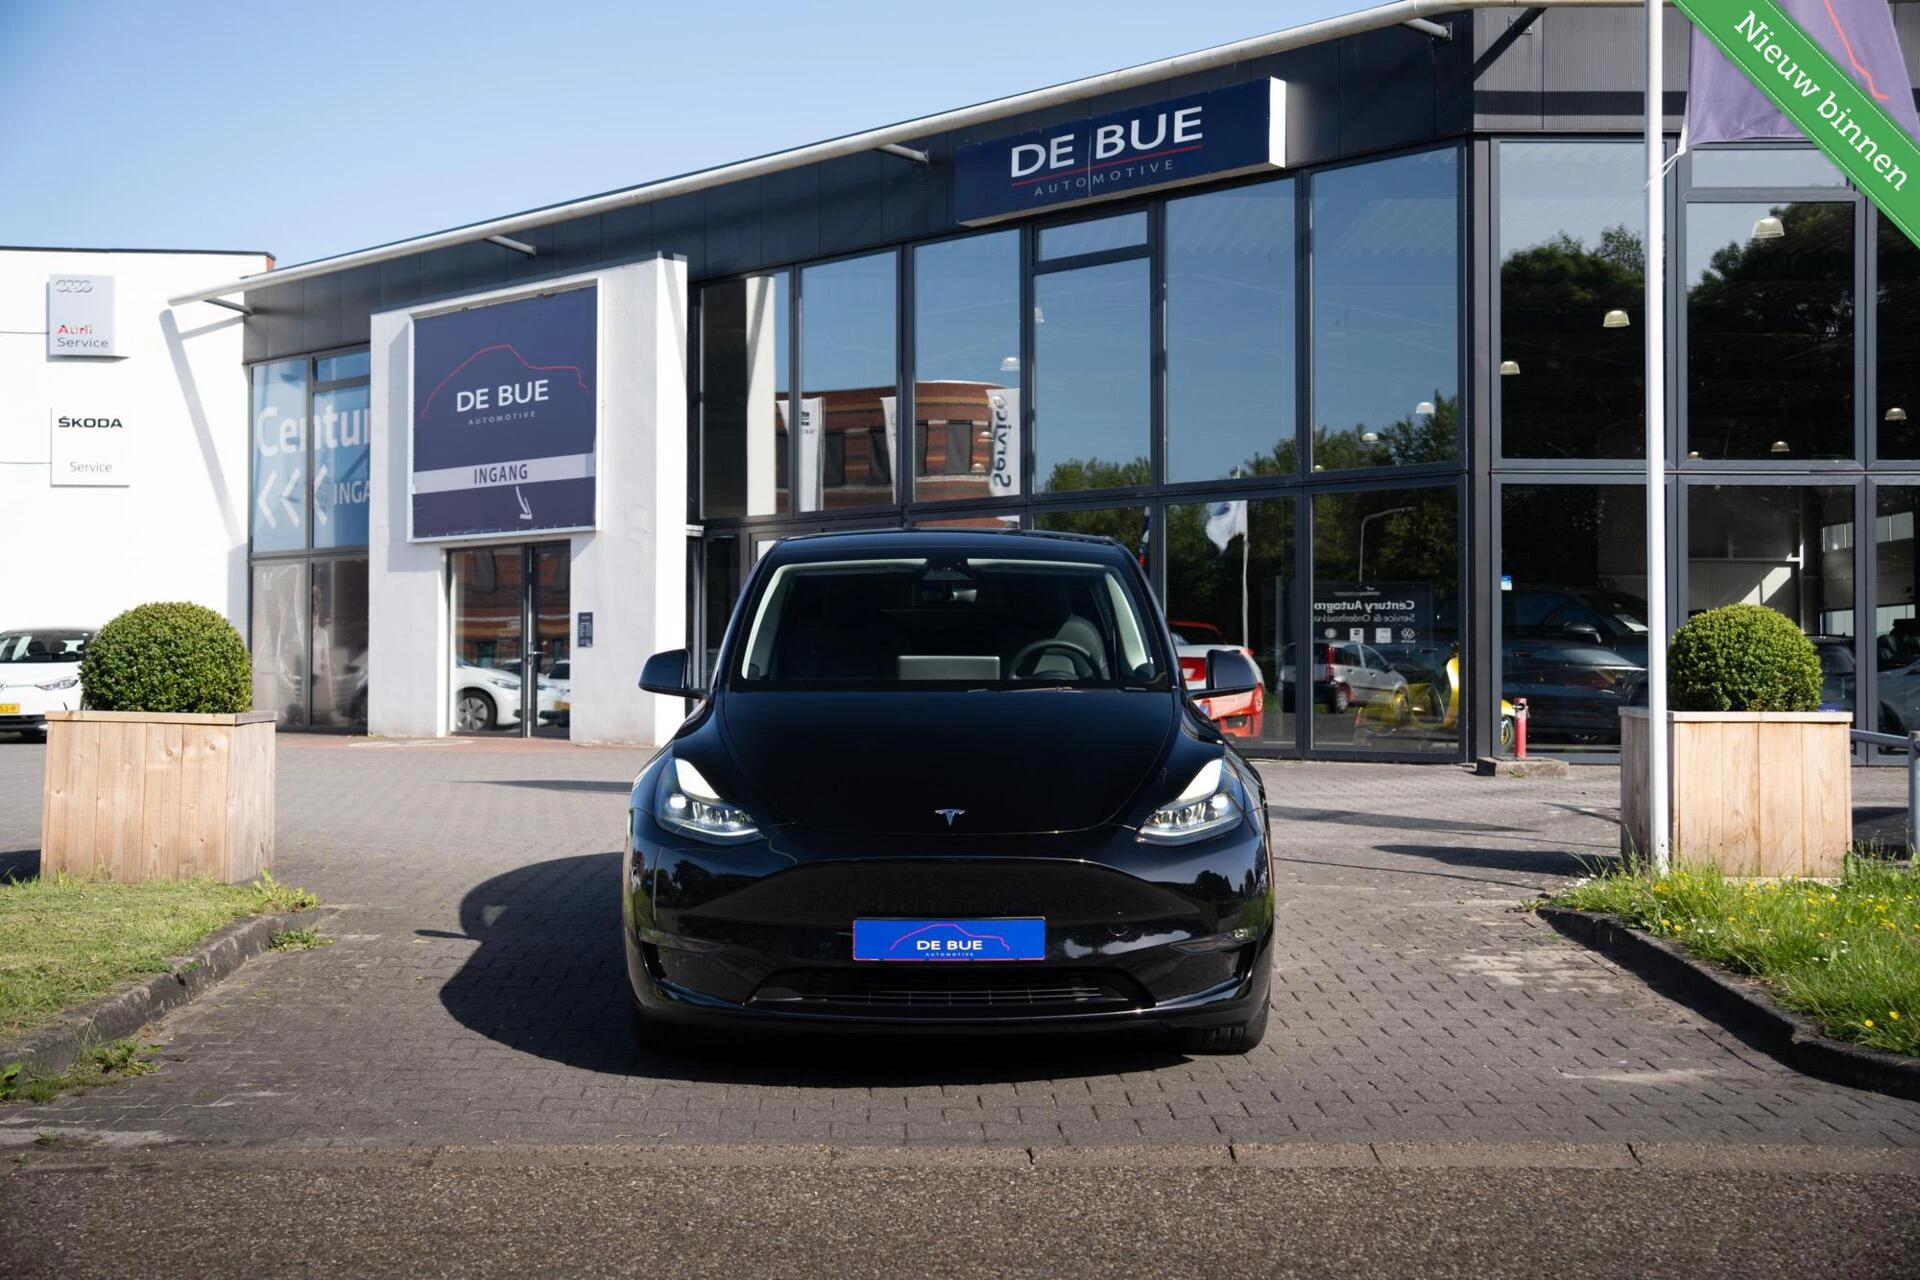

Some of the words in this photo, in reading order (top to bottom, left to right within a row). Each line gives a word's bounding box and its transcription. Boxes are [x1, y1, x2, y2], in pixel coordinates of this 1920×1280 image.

[1010, 133, 1075, 178] DE
[1095, 106, 1203, 160] BUE
[1034, 159, 1174, 197] AUTOMOTIVE
[57, 324, 93, 335] Audi
[57, 336, 109, 348] Service
[456, 388, 489, 413] DE
[498, 379, 550, 407] BUE
[58, 416, 123, 429] ŠKODA
[468, 410, 537, 425] AUTOMOTIVE
[70, 461, 113, 473] Service
[473, 463, 528, 484] INGANG
[916, 940, 941, 951] DE
[947, 940, 983, 951] BUE
